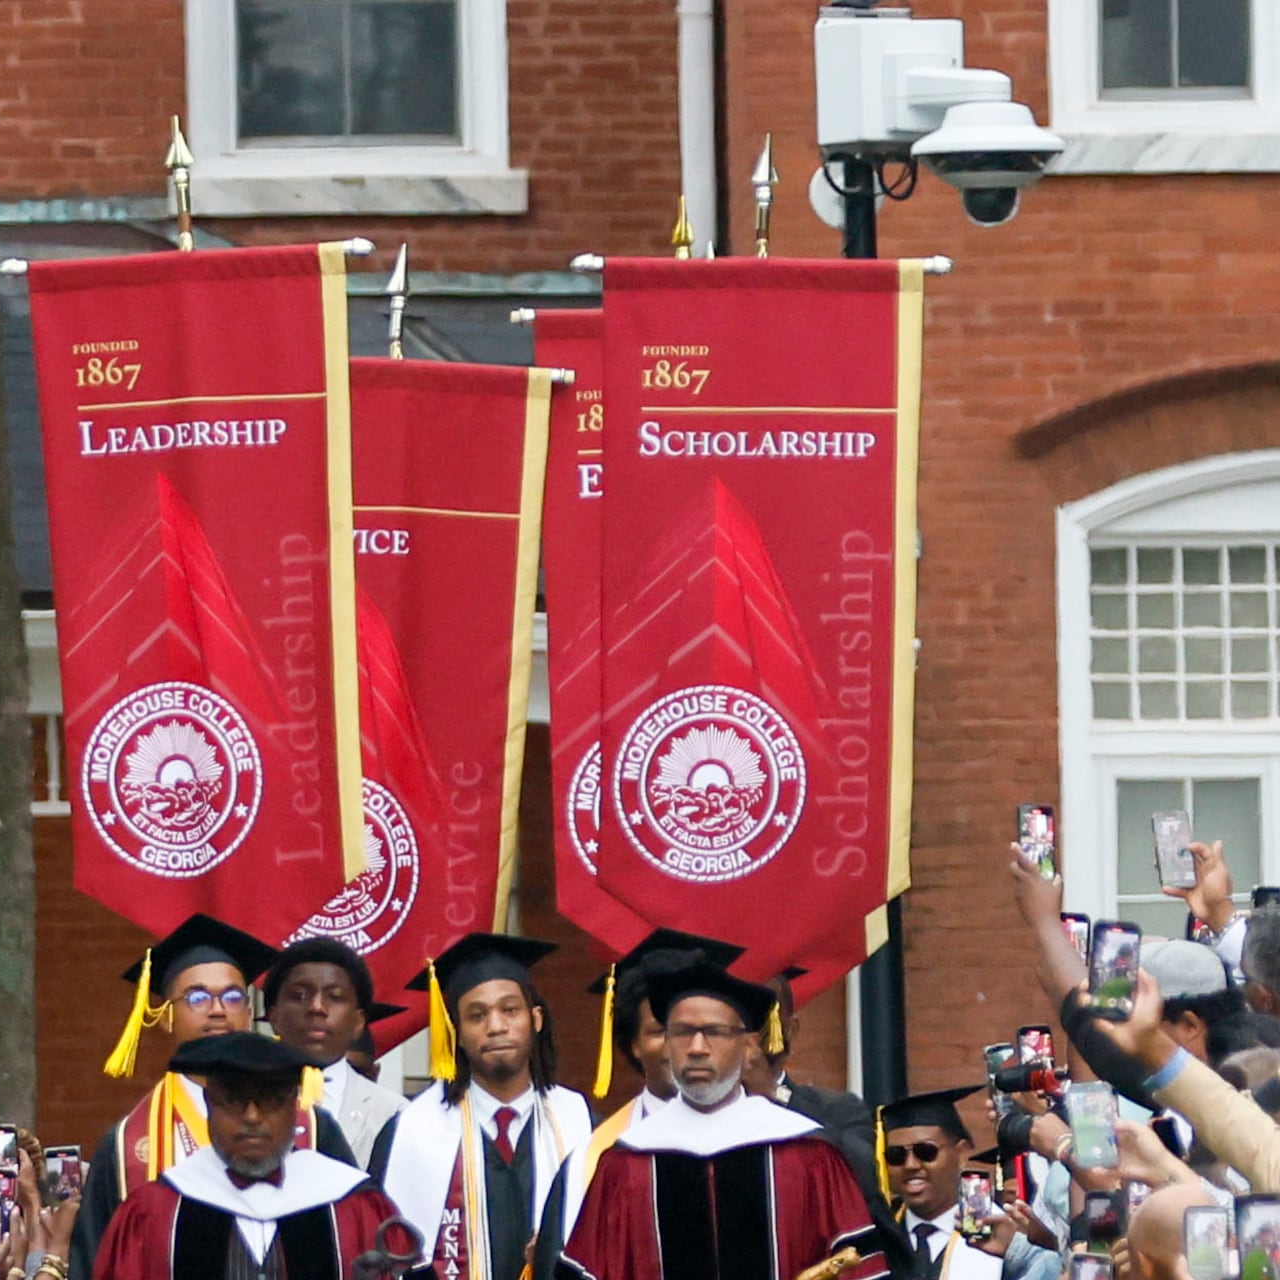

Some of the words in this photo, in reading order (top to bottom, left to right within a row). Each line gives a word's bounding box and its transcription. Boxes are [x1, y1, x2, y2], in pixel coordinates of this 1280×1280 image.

[72, 339, 139, 355] FOUNDED
[642, 345, 710, 357] FOUNDED
[75, 356, 142, 392] 1867
[641, 359, 711, 395] 1867
[576, 403, 603, 432] 18
[78, 418, 288, 455] LEADERSHIP
[638, 421, 876, 458] SCHOLARSHIP
[262, 533, 328, 866] Leadership
[812, 528, 893, 877] Scholarship
[90, 690, 186, 781] MOREHOUSE
[188, 693, 254, 773] COLLEGE
[622, 694, 728, 781] MOREHOUSE
[732, 698, 798, 782] COLLEGE
[131, 811, 148, 829] ET
[146, 823, 186, 843] FACTA
[186, 827, 203, 842] EST
[202, 809, 220, 832] LUX
[362, 786, 413, 868] COLLEGE
[658, 815, 673, 832] ET
[673, 826, 713, 848] FACTA
[713, 833, 735, 848] EST
[736, 815, 760, 839] LUX
[140, 842, 218, 869] GEORGIA
[664, 849, 752, 873] GEORGIA
[309, 914, 334, 928] CTA
[334, 914, 356, 929] EST
[356, 898, 379, 921] LUX
